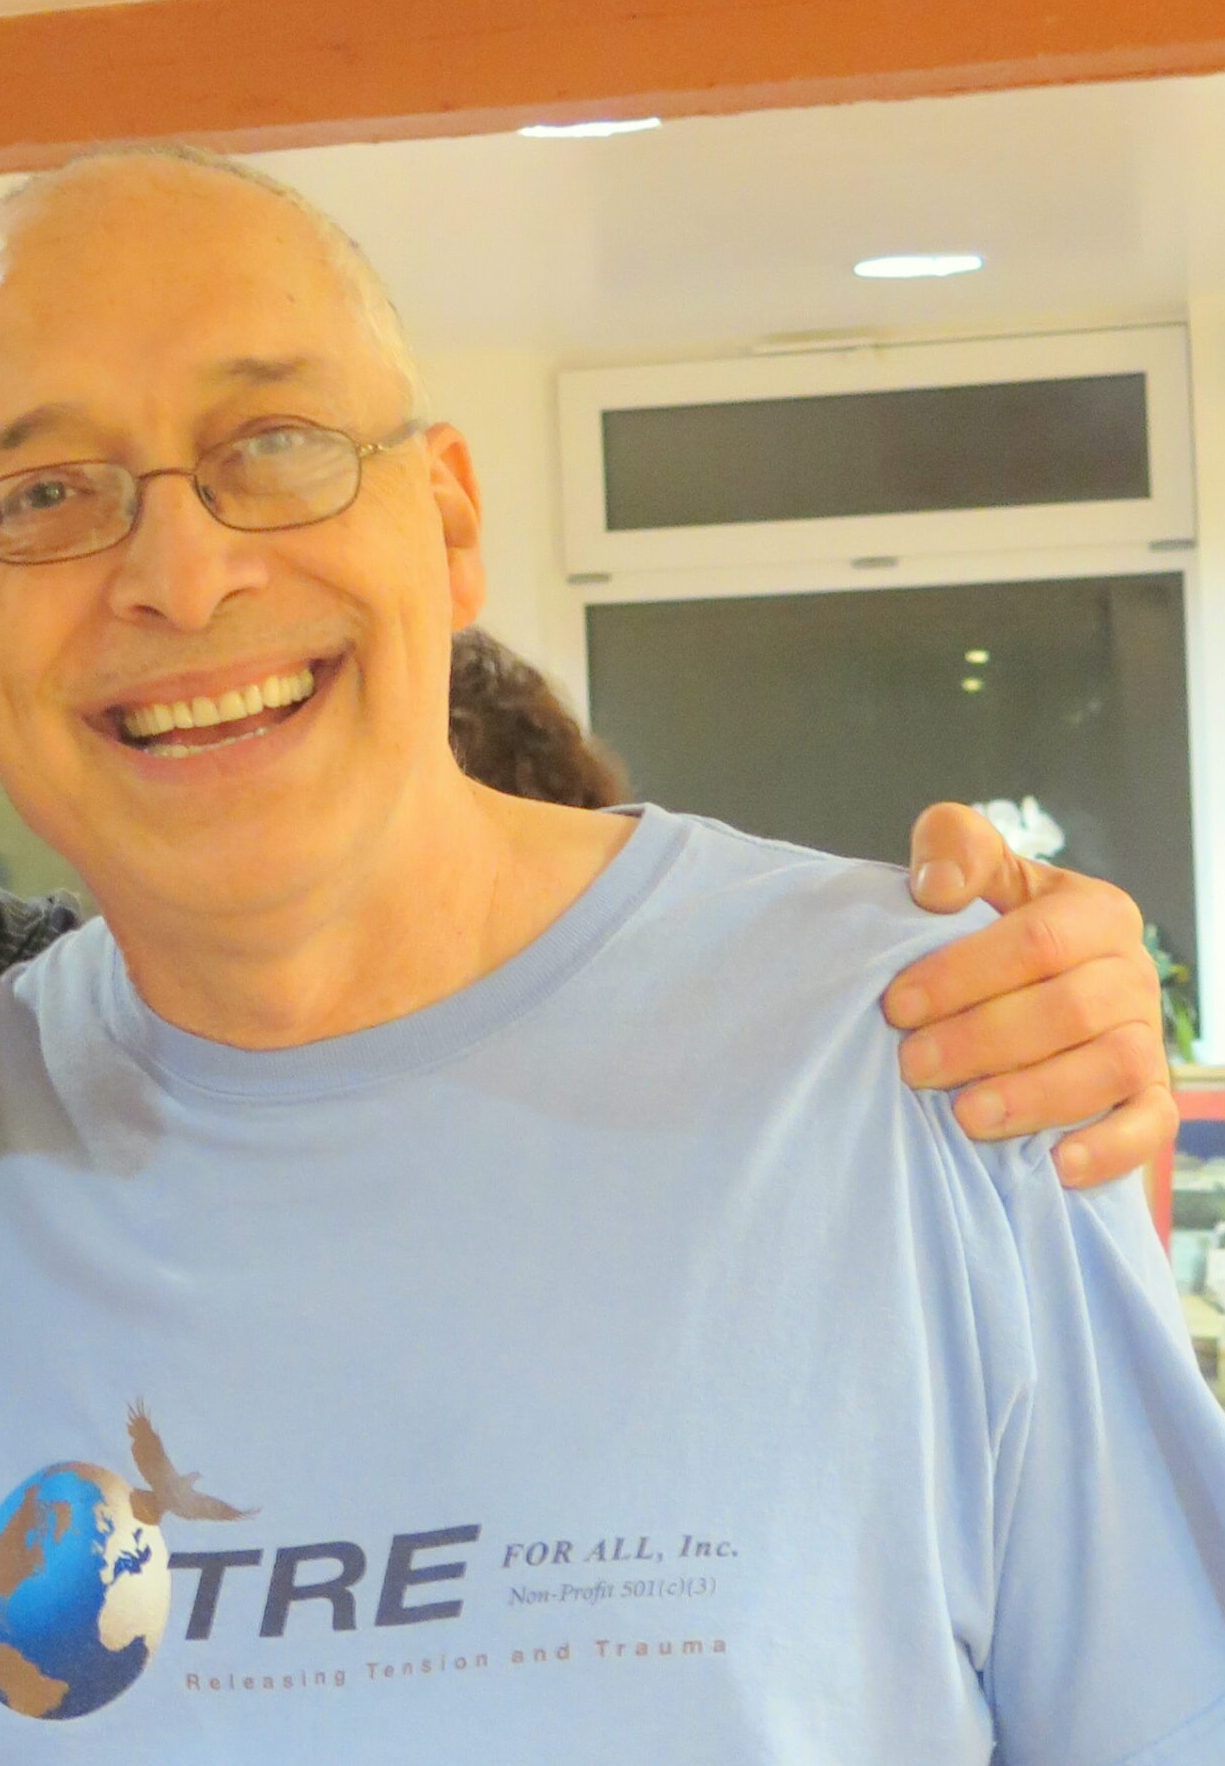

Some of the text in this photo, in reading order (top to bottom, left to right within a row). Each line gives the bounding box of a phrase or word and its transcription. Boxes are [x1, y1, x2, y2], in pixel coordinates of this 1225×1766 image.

[167, 1525, 739, 1640] TRE FOR ALL, Inc.
[509, 1576, 717, 1606] Non-Profit 501(c)(3)
[185, 1638, 726, 1692] Releasing Tension and Trauma
